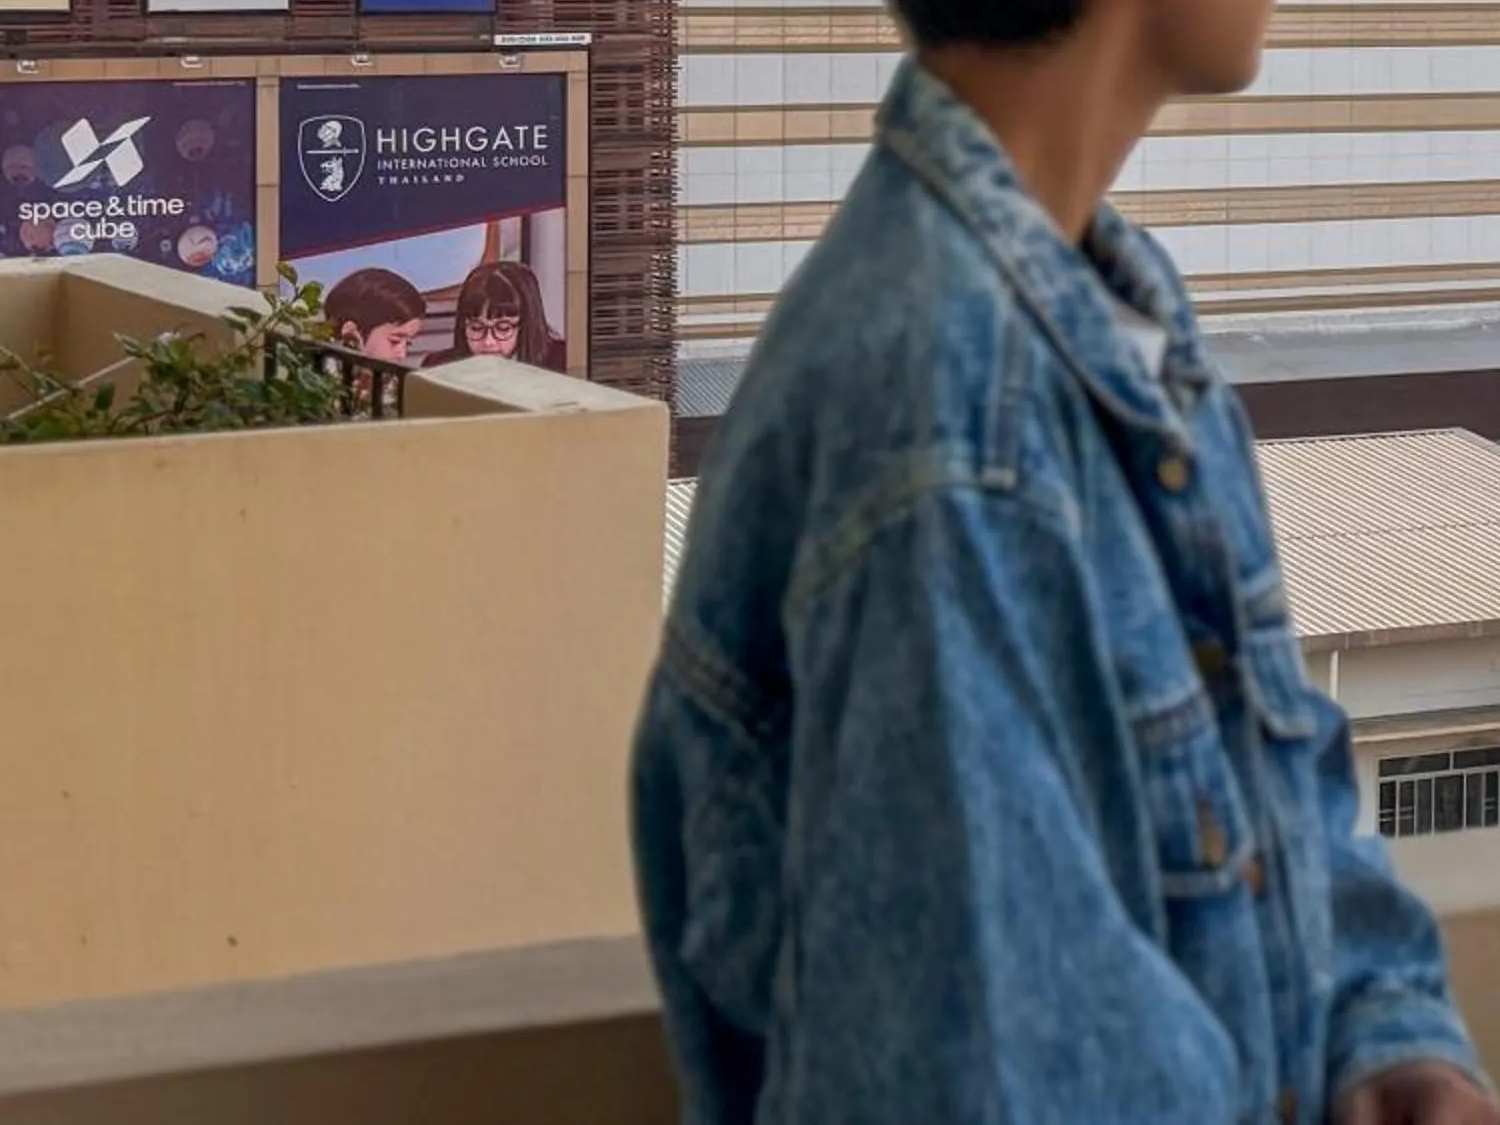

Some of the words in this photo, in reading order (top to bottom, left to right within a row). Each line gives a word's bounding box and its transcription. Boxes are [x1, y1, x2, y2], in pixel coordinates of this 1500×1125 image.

[376, 125, 548, 153] HIGHGATE
[377, 156, 487, 171] INTERNATIONAL
[493, 154, 548, 168] SCHOOL
[378, 174, 465, 185] THAILAND
[18, 200, 103, 226] space
[105, 195, 126, 217] &
[127, 194, 185, 216] time
[69, 216, 136, 240] cube
